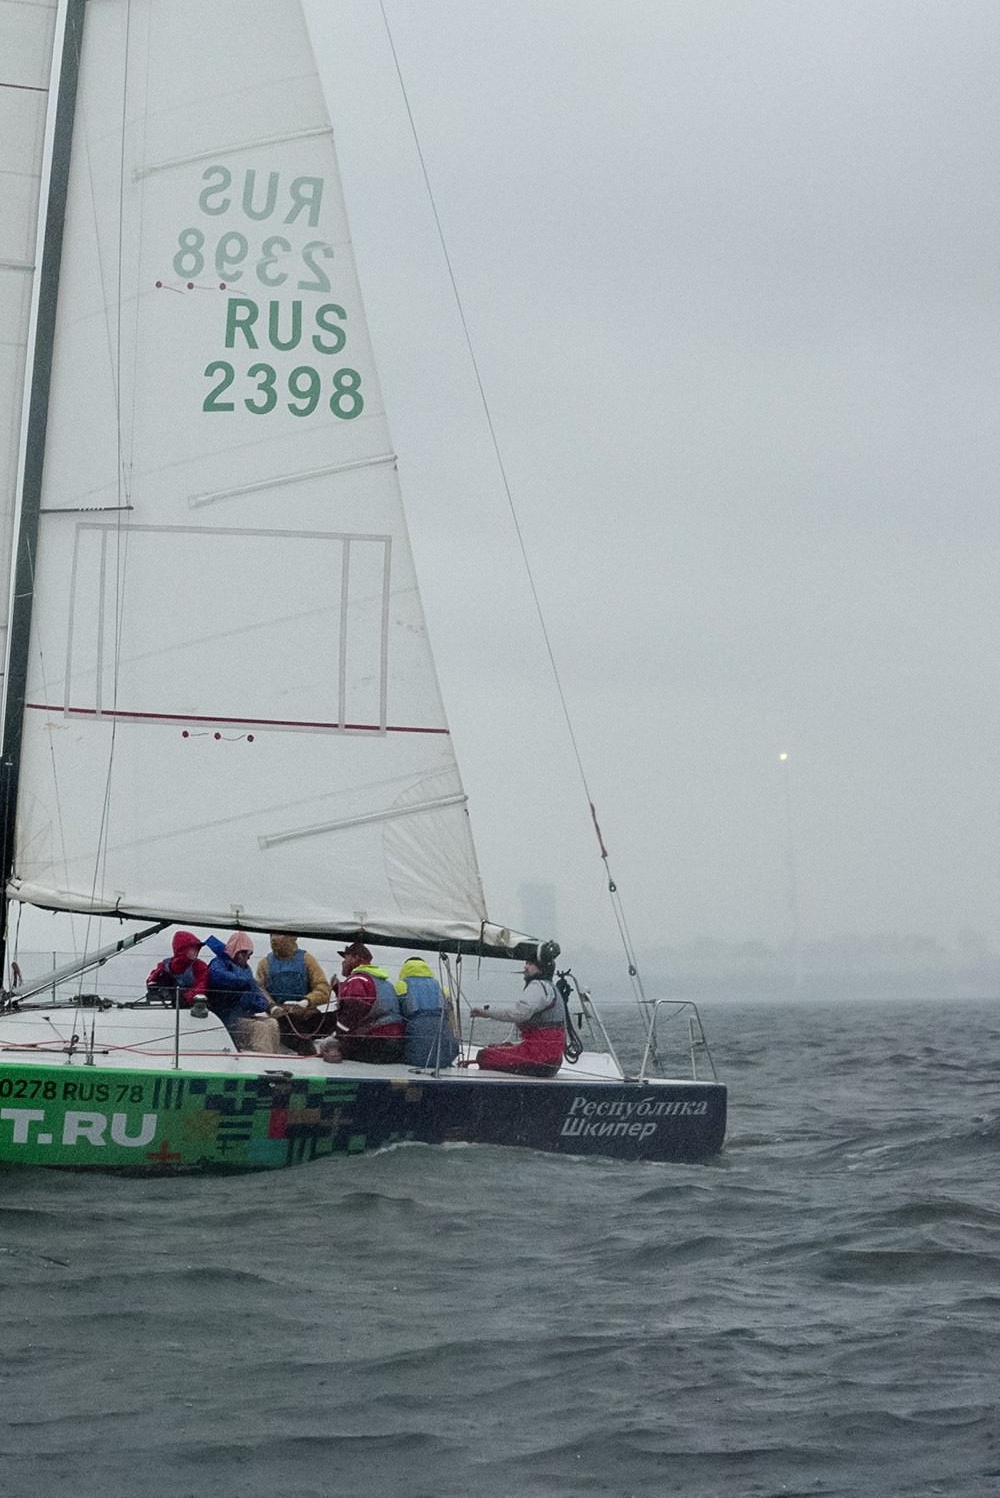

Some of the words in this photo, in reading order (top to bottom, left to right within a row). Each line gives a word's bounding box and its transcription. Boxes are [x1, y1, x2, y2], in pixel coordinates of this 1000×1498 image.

[224, 298, 348, 355] RUS
[202, 360, 365, 420] 2398
[62, 1082, 110, 1102] RUS
[116, 1084, 144, 1103] 78
[567, 1096, 709, 1120] Республика
[560, 1117, 658, 1141] Шкипер
